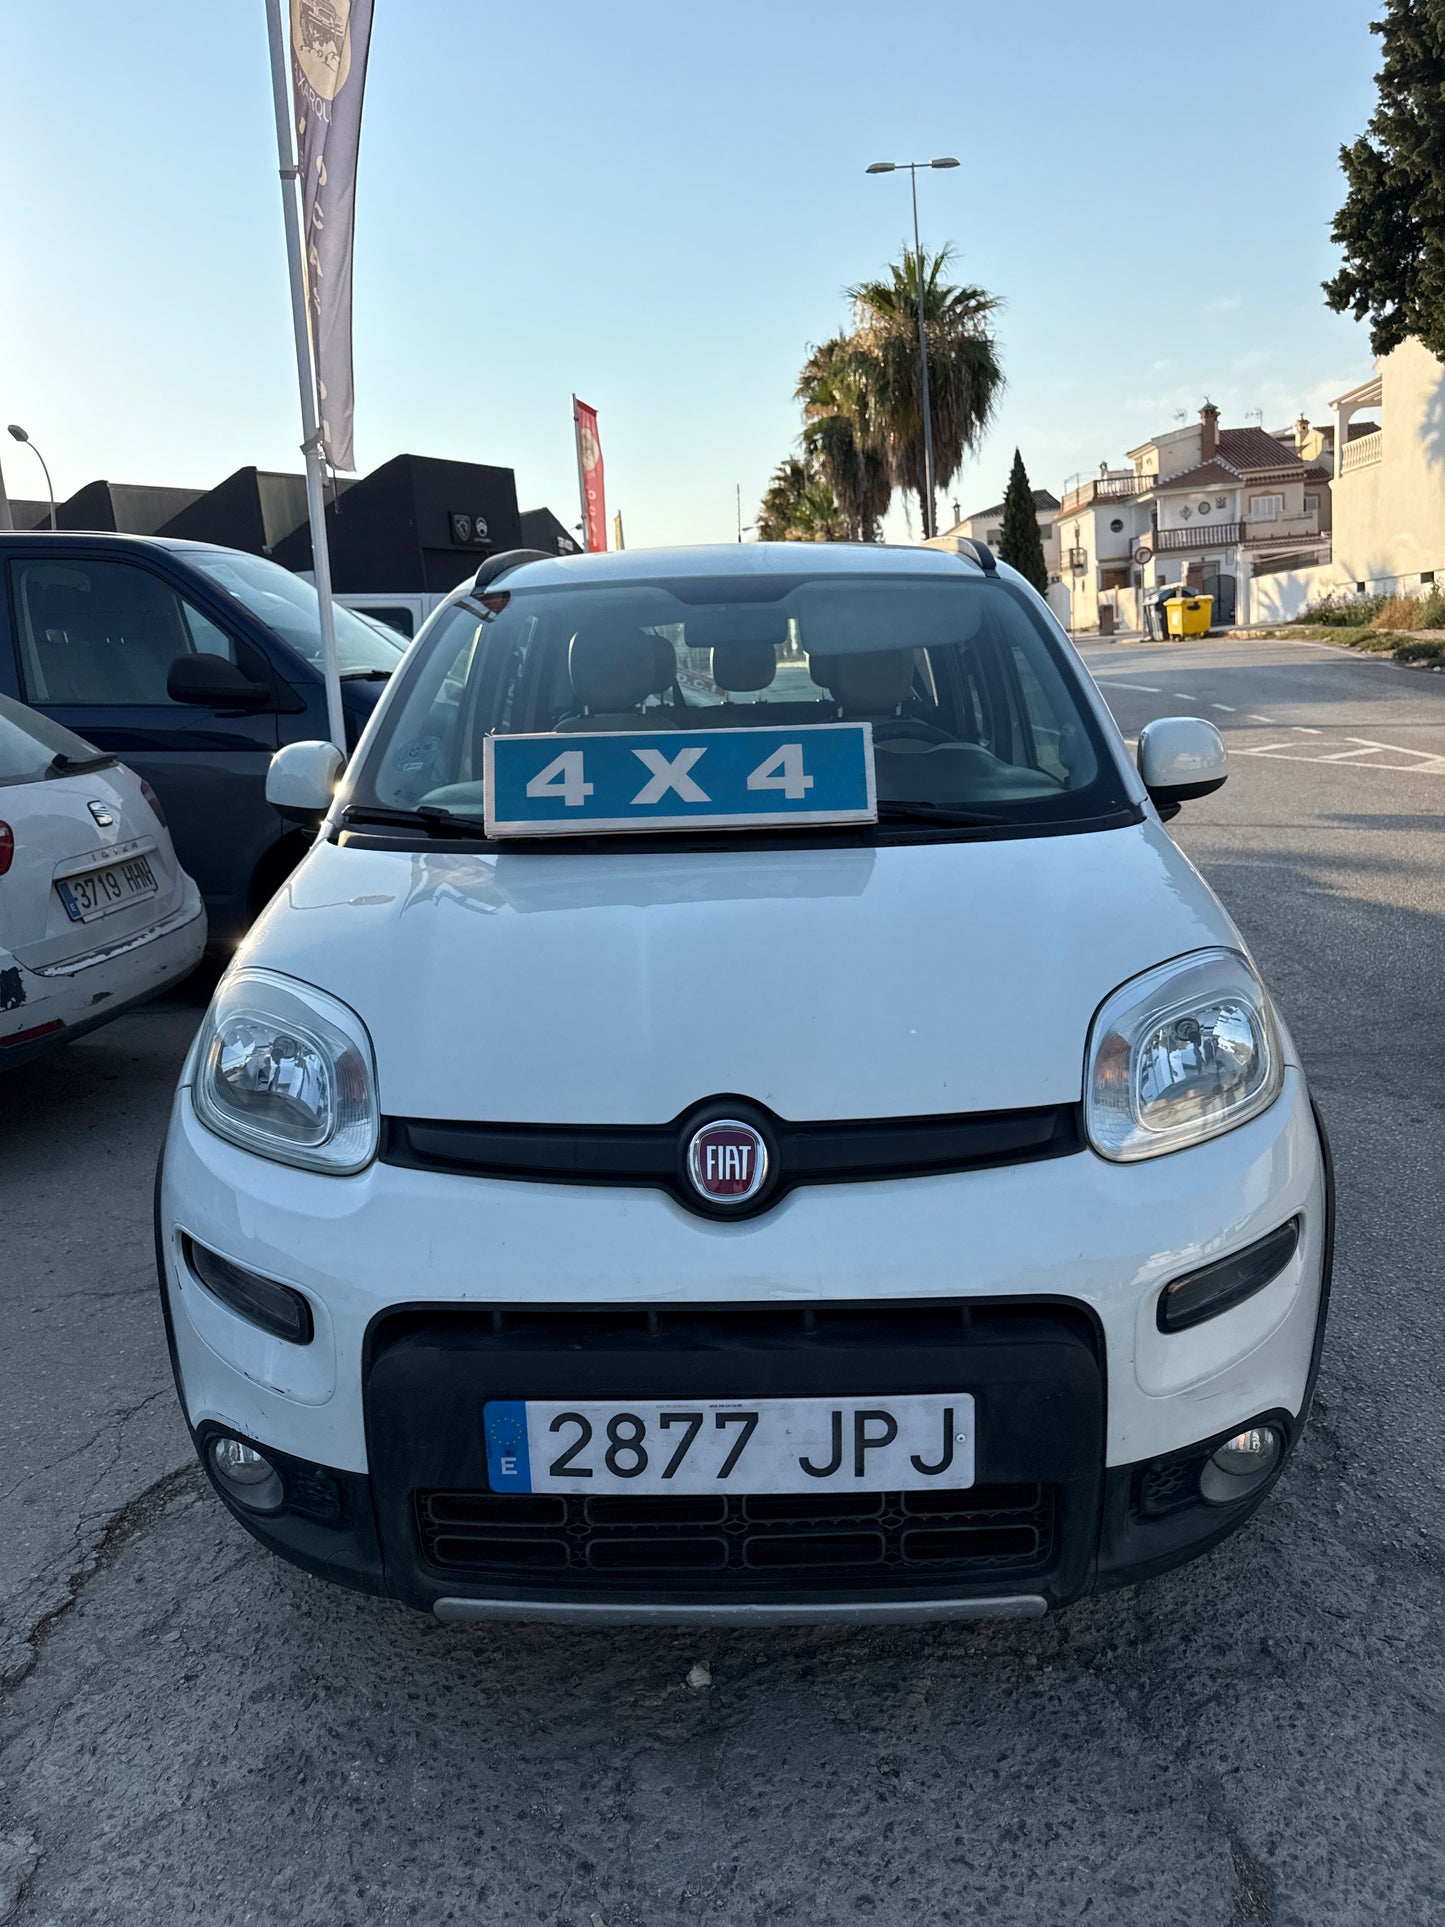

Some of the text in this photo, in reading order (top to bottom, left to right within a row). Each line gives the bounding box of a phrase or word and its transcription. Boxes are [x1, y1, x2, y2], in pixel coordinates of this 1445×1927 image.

[526, 744, 814, 806] 4 X 4
[74, 872, 121, 908] 3719
[121, 861, 153, 893] HHN
[706, 1145, 752, 1180] FIAT
[501, 1408, 954, 1479] E 2877 JPJ
